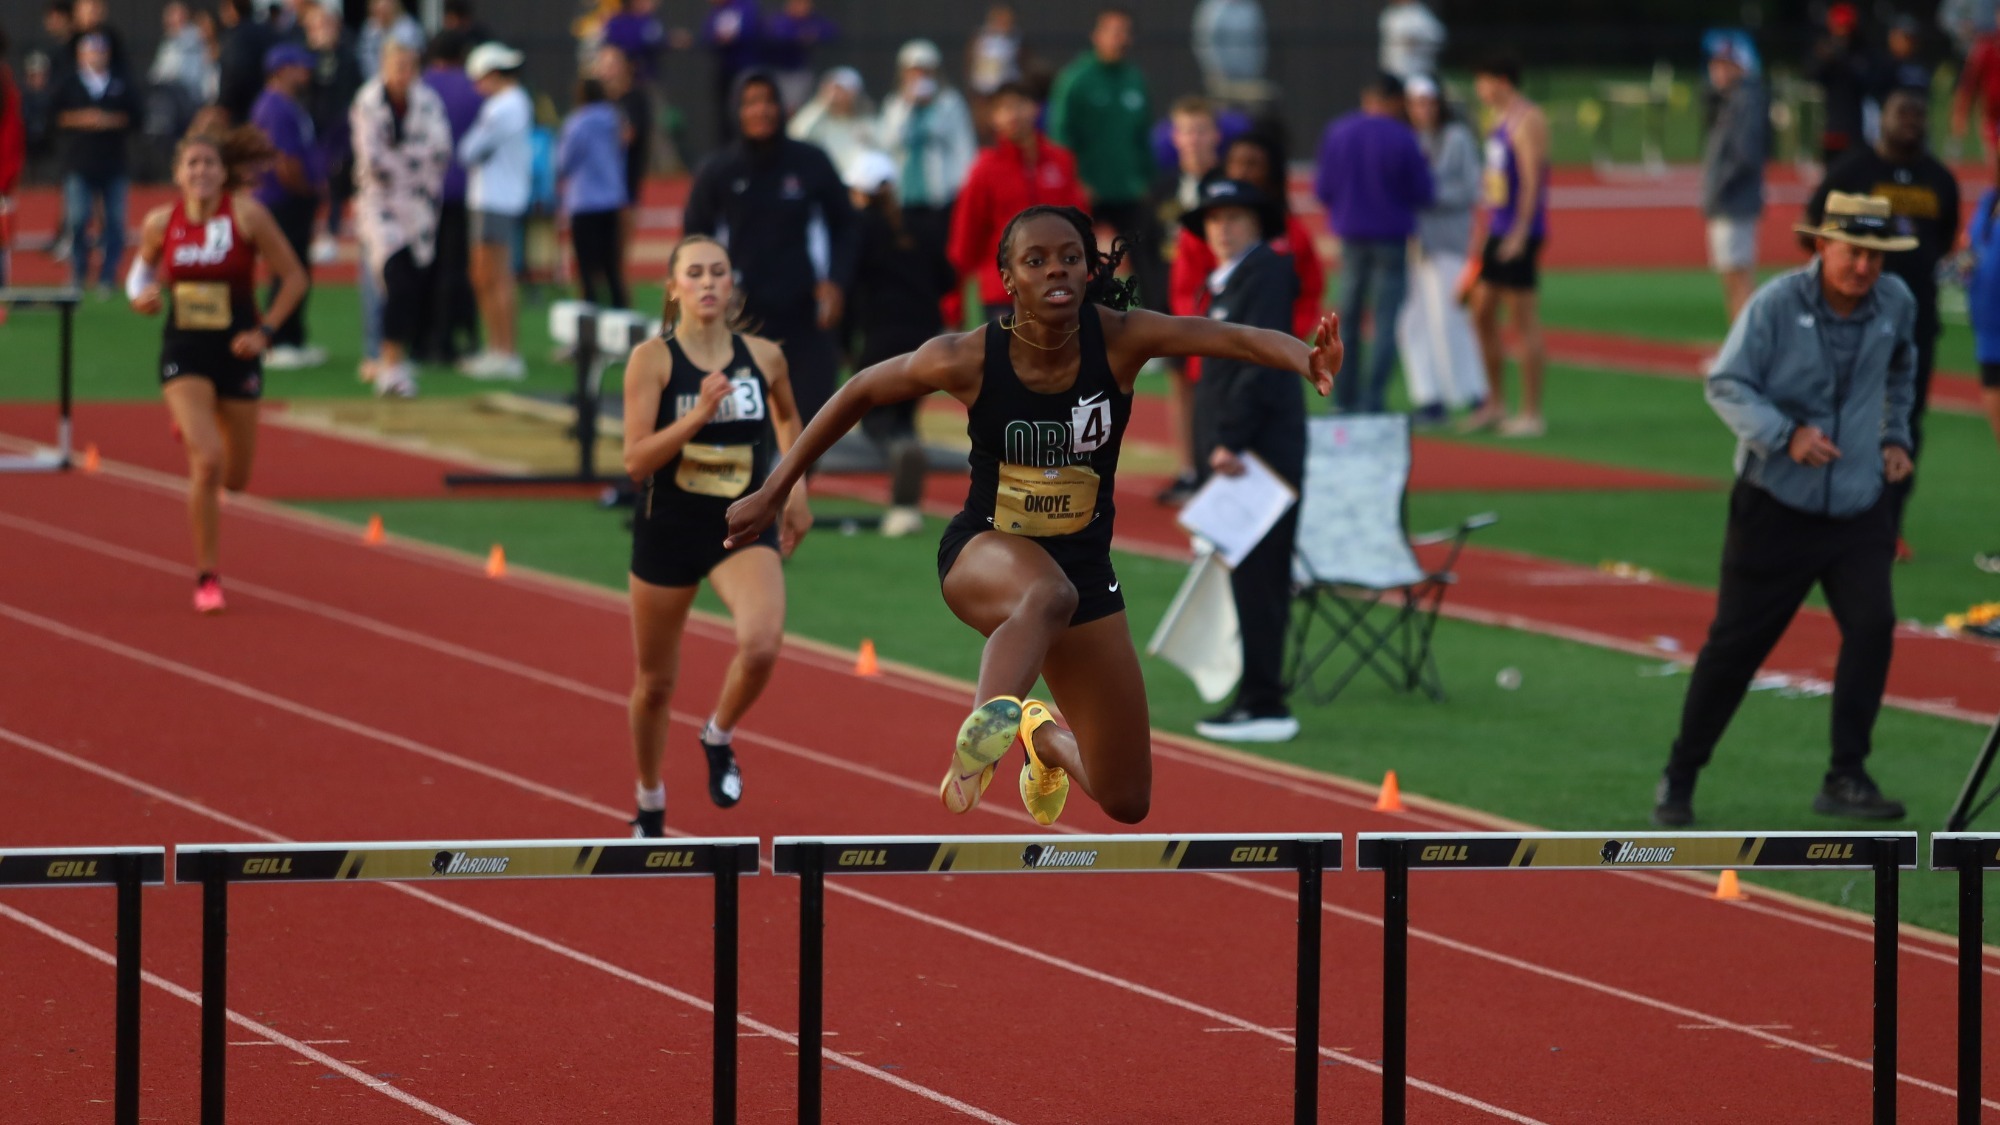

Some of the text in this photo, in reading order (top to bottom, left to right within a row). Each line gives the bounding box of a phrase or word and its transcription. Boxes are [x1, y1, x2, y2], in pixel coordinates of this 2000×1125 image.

[739, 382, 757, 415] 3
[1081, 406, 1106, 448] 4
[1024, 494, 1071, 513] OKOYE
[1047, 512, 1074, 520] OKLAHOMA
[645, 851, 695, 867] GILL
[838, 850, 887, 866] GILL
[1230, 846, 1279, 862] GILL
[1421, 845, 1469, 861] GILL
[1806, 843, 1854, 859] GILL
[46, 860, 98, 877] GILL
[242, 858, 292, 874] GILL
